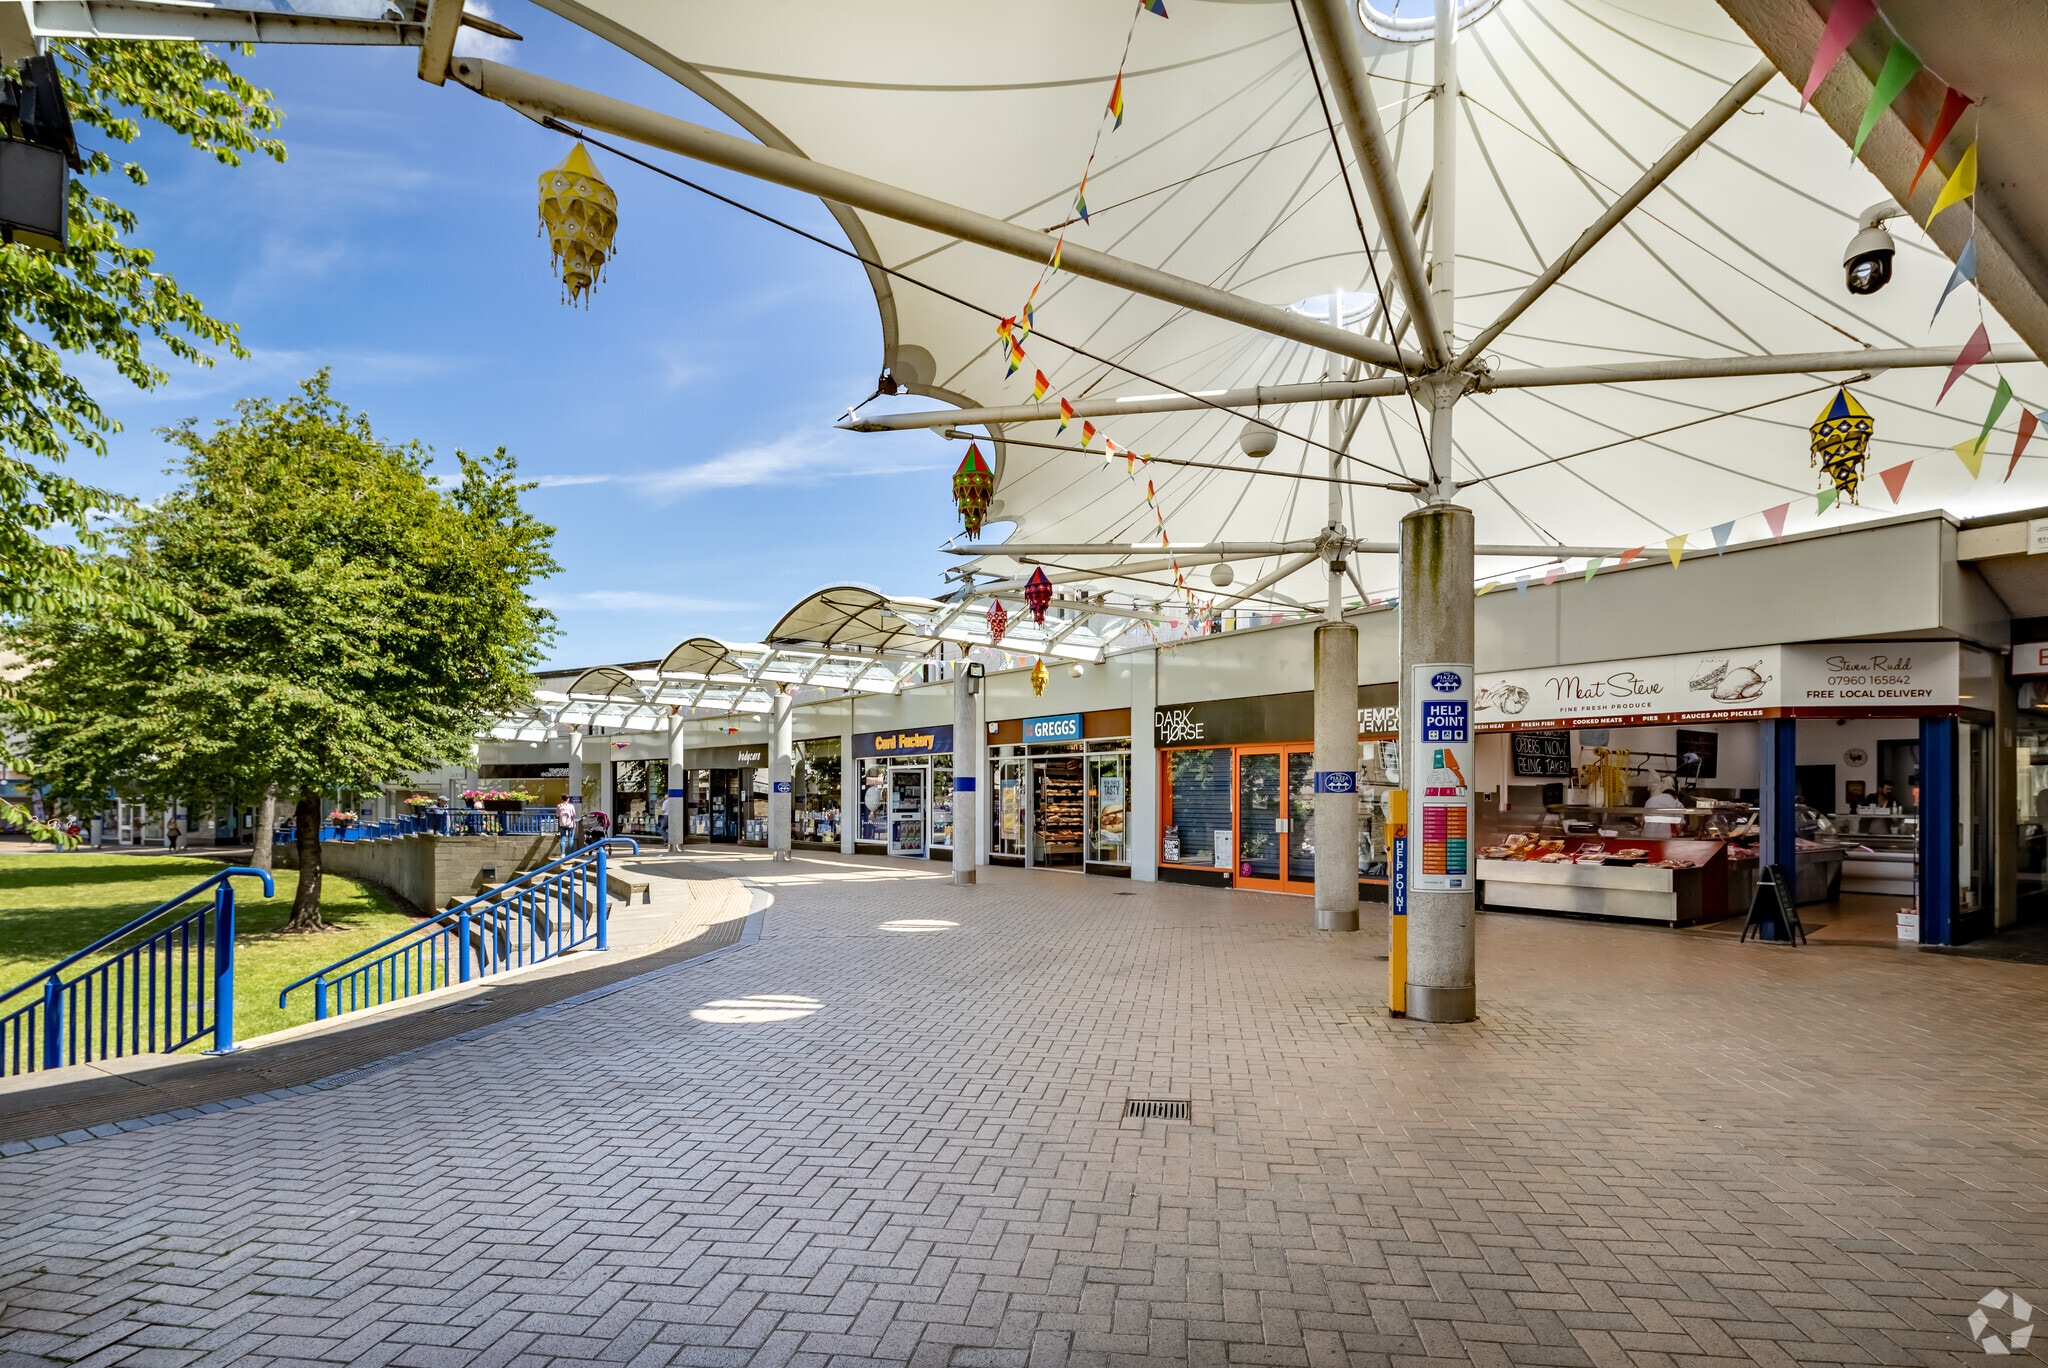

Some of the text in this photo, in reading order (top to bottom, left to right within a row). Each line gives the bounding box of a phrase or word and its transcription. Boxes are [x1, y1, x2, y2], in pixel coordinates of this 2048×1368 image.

[1826, 655, 1912, 672] Steven Rudd
[1544, 672, 1664, 701] Meat Steve
[1828, 675, 1911, 685] 07960 165842
[1806, 689, 1932, 698] FREE LOCAL DELIVERY
[1430, 705, 1462, 716] HELP
[1581, 704, 1608, 712] FRESH
[1611, 702, 1652, 710] PRODUCE
[1681, 712, 1711, 720] SAUCES
[1730, 709, 1763, 717] PICKLES
[1155, 706, 1194, 728] DARK
[1426, 716, 1465, 727] POINT
[1034, 719, 1076, 737] GREGGS
[875, 733, 935, 751] Card Factory
[1515, 737, 1567, 755] ORDERS NOW
[737, 750, 761, 765] bodycare
[1517, 757, 1570, 773] BEING TAKEN
[1104, 785, 1120, 796] TASTY
[1395, 840, 1404, 912] HELP POINT
